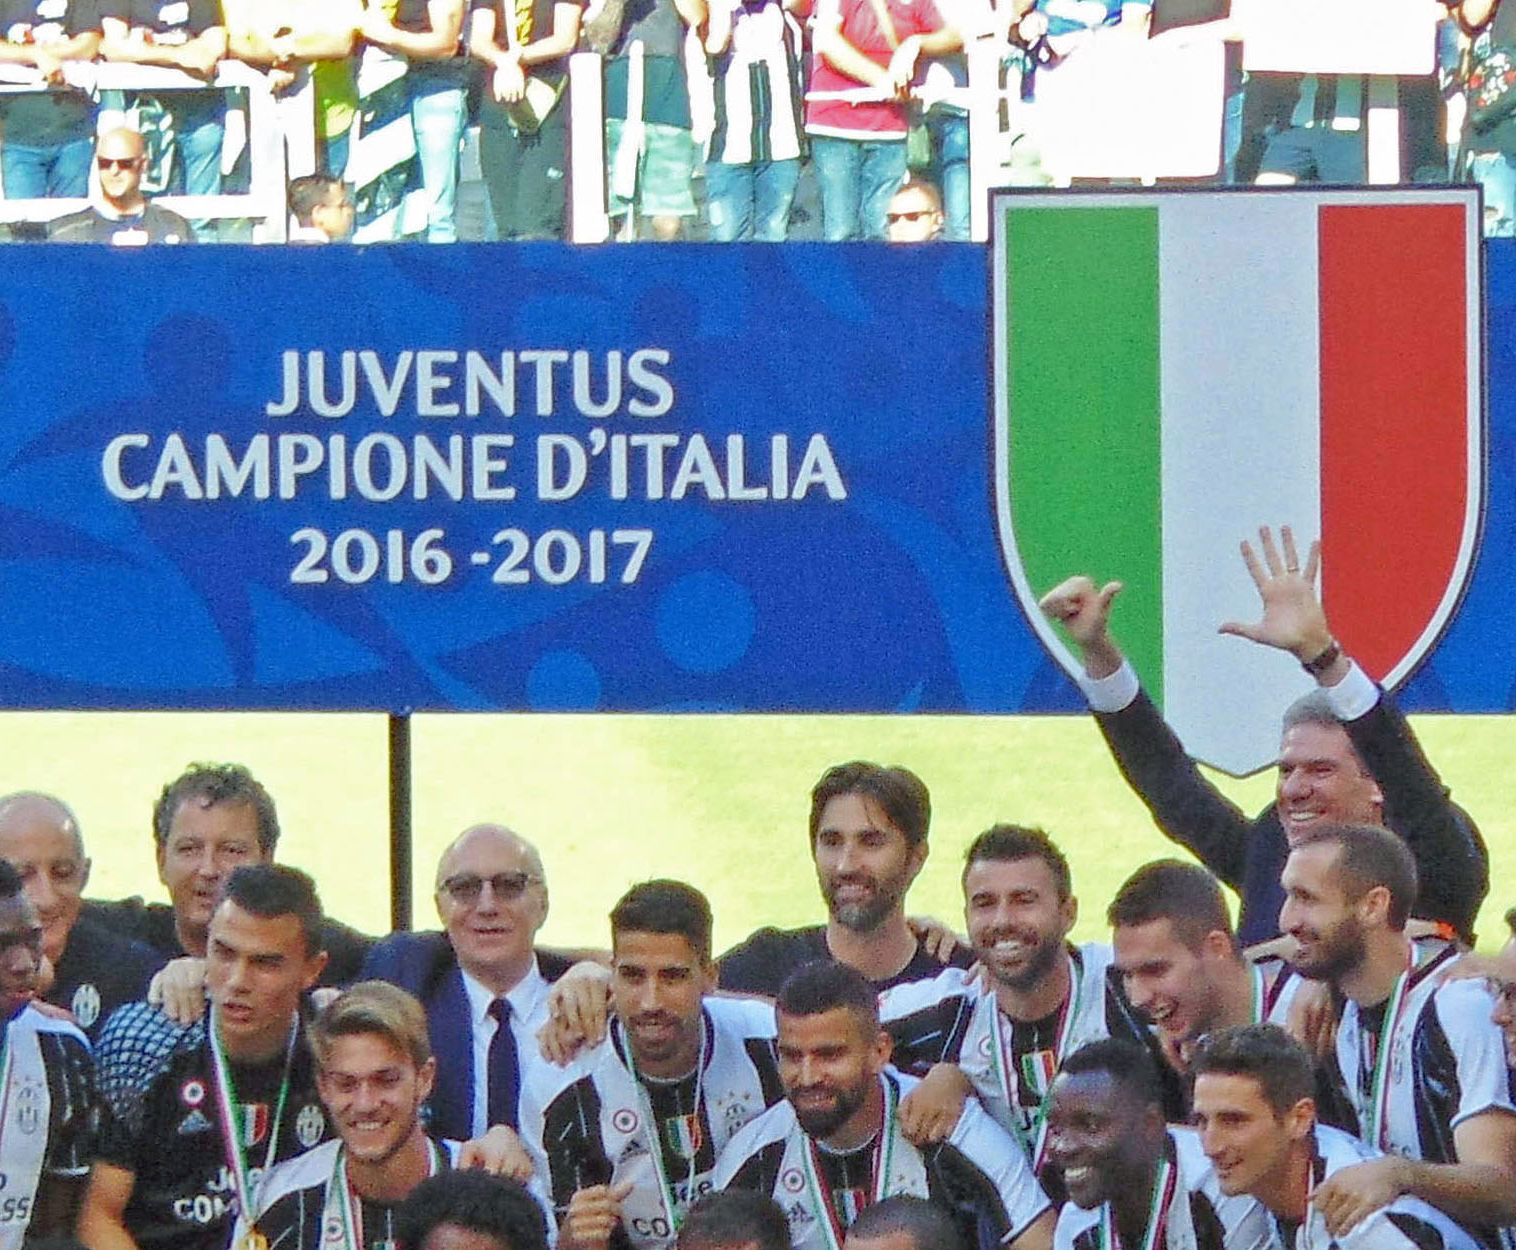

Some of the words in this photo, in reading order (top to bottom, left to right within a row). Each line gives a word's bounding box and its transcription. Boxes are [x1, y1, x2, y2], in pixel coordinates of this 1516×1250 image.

[267, 349, 674, 418] JUVENTUS
[102, 433, 515, 501] CAMPIONE
[290, 528, 452, 584] 2016
